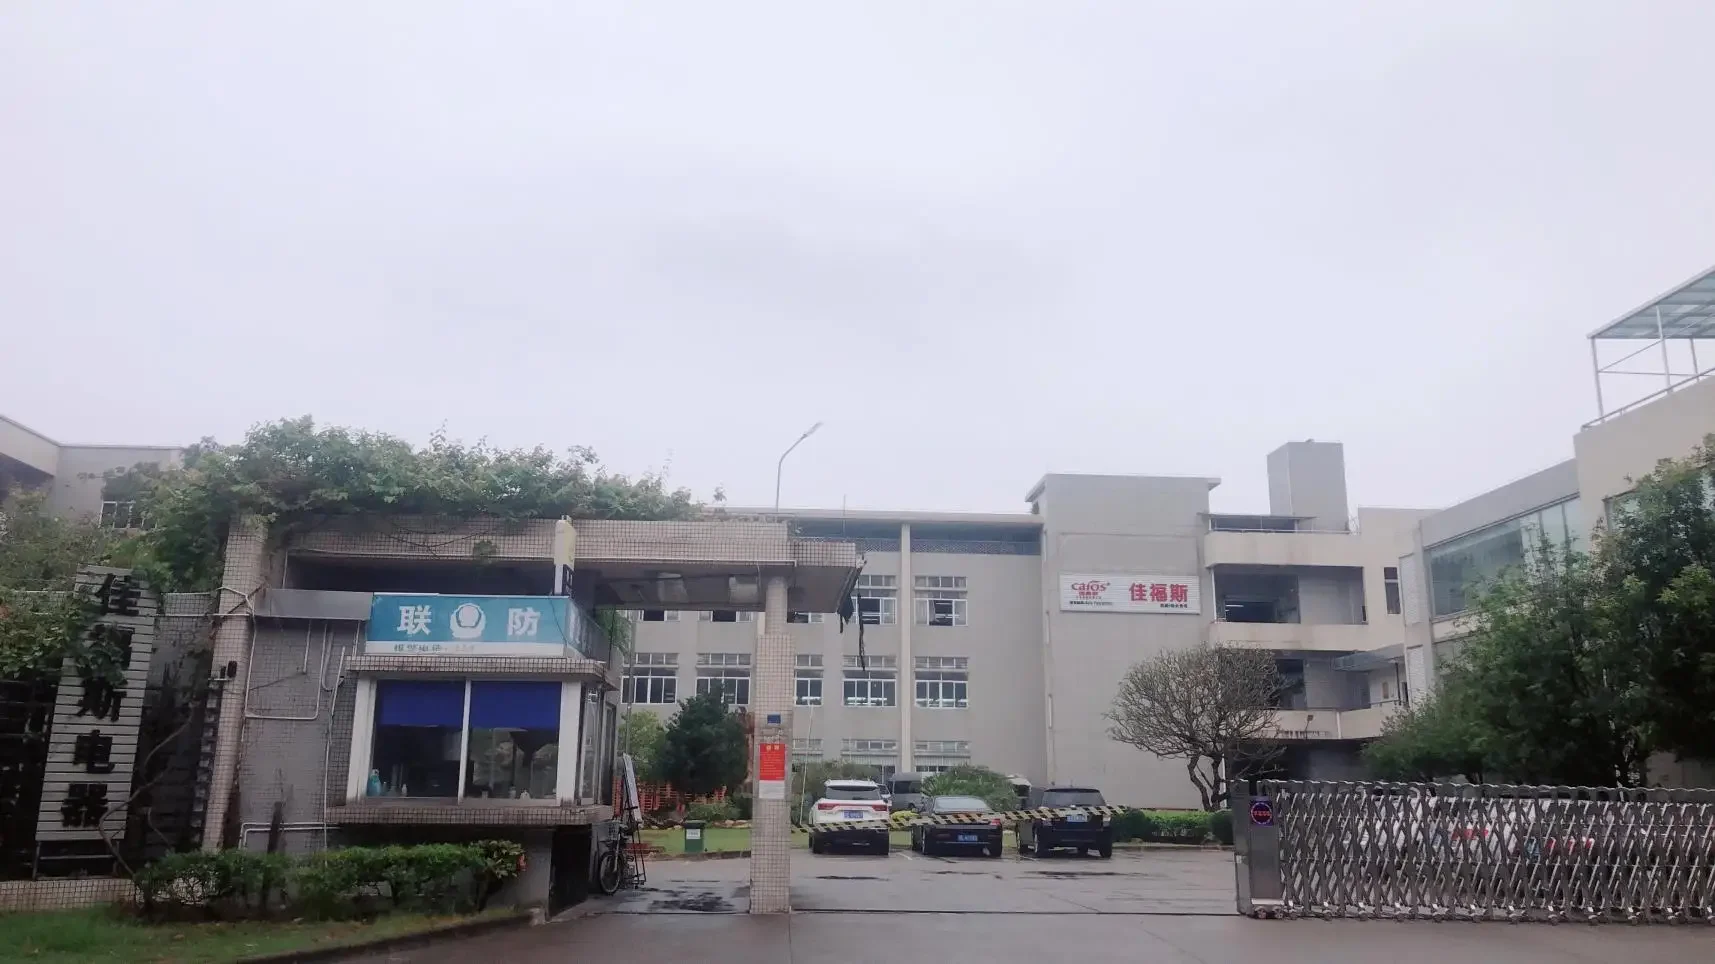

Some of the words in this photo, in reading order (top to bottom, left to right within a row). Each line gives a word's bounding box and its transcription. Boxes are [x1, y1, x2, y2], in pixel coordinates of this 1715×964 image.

[1128, 582, 1188, 602] 佳福斯
[397, 605, 432, 637] 联
[507, 606, 542, 637] 防
